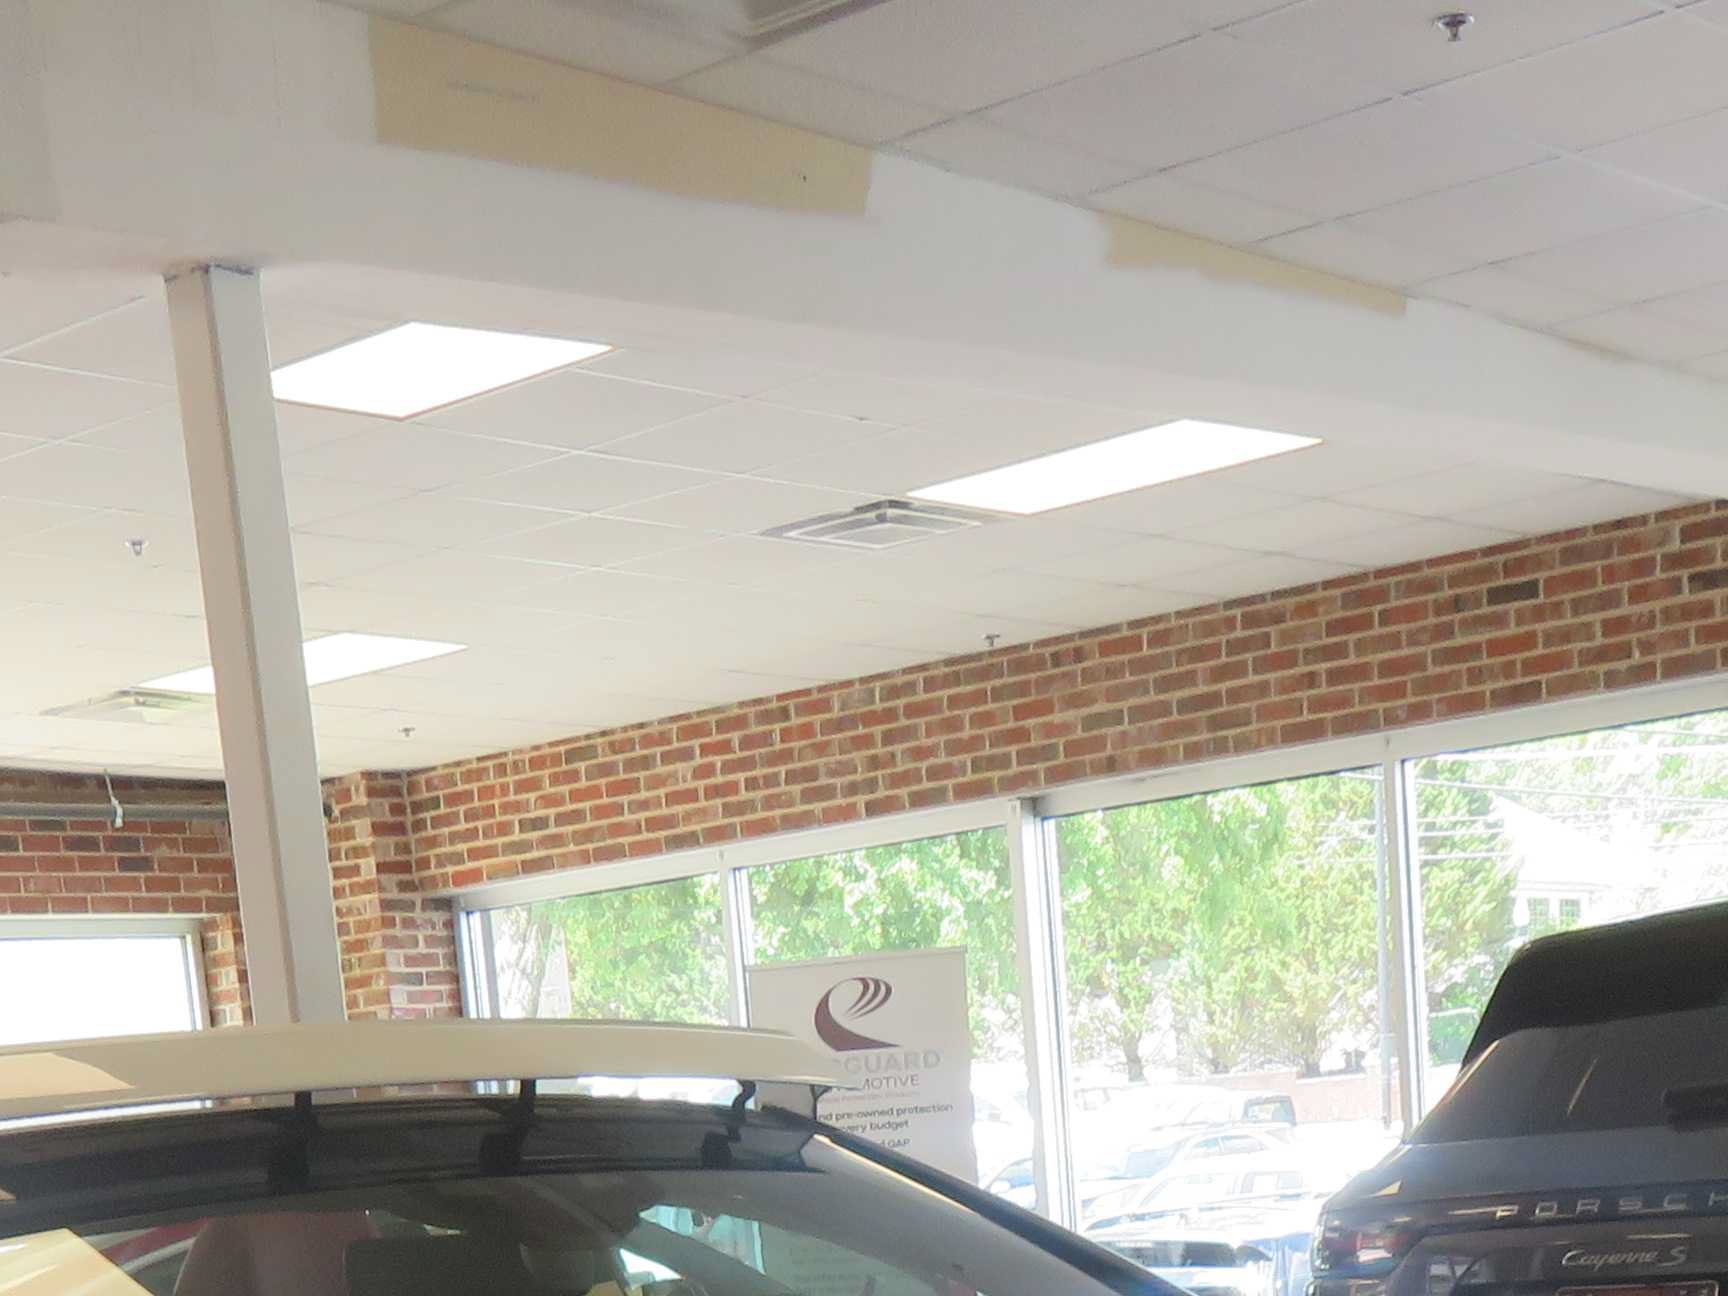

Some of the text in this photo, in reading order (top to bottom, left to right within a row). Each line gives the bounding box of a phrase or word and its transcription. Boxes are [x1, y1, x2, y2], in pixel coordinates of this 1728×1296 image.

[836, 1050, 941, 1074] GUARD
[818, 1102, 954, 1122] nd pre-owned protection
[870, 1119, 910, 1133] budget
[1561, 1246, 1688, 1271] Cayenne S
